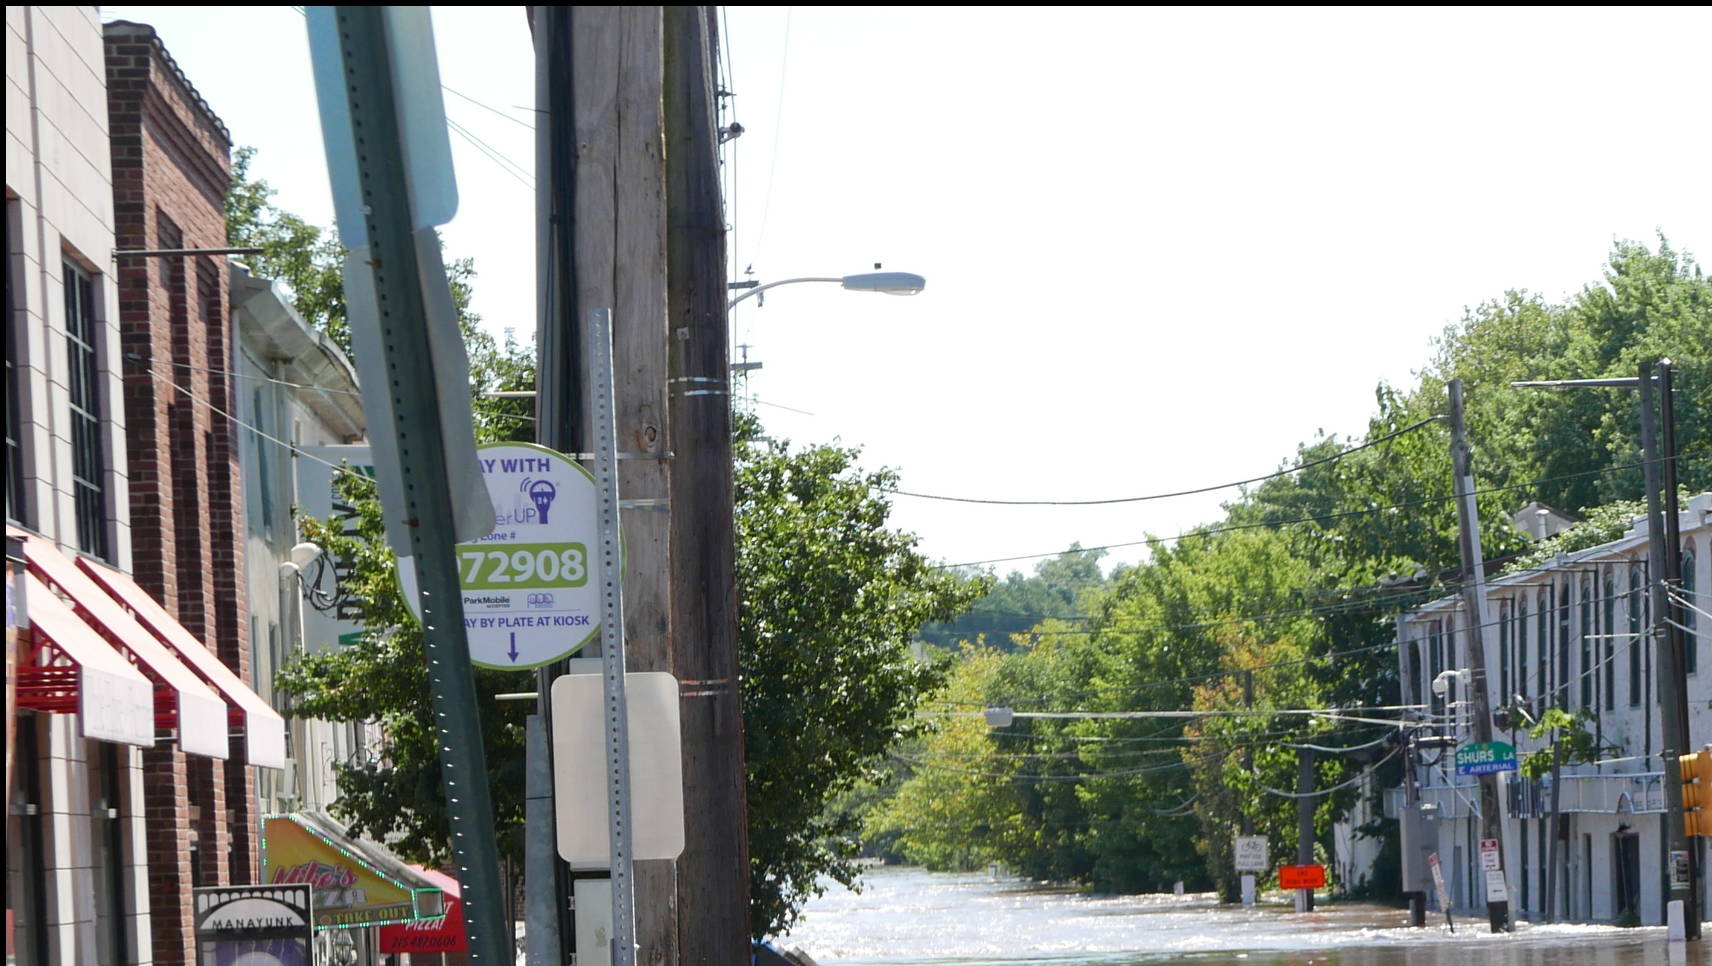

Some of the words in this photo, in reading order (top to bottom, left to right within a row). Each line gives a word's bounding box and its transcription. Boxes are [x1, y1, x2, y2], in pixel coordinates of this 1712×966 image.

[501, 458, 551, 473] WITH
[456, 549, 585, 584] 72908
[480, 616, 496, 628] BY
[498, 615, 534, 628] PLATE
[536, 615, 551, 627] AT
[553, 614, 590, 626] KIOSK
[1457, 750, 1495, 765] SHURS
[1502, 751, 1514, 761] LA
[212, 916, 294, 929] MANAYUNK
[335, 910, 371, 923] TAKE
[378, 907, 409, 919] OUT
